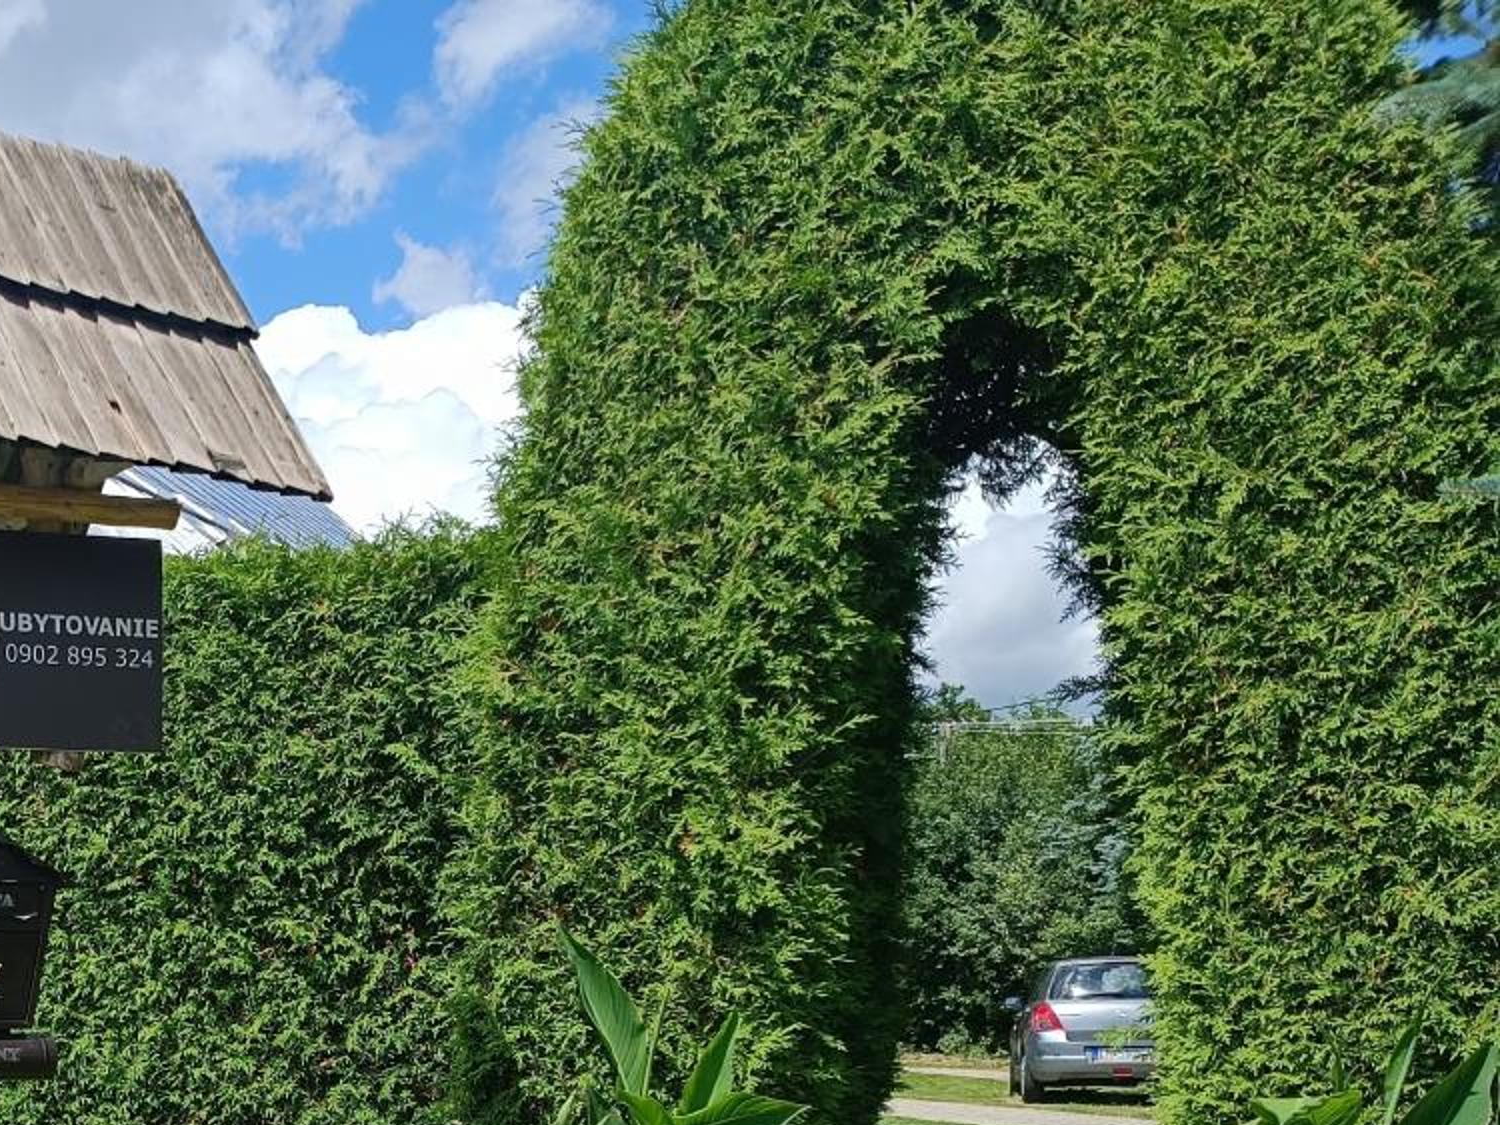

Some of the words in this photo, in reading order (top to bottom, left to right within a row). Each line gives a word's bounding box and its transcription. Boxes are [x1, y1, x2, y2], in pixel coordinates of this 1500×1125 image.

[0, 611, 159, 639] UBYTOVANIE
[5, 643, 59, 665] 0902
[67, 645, 107, 667] 895
[115, 647, 153, 669] 324
